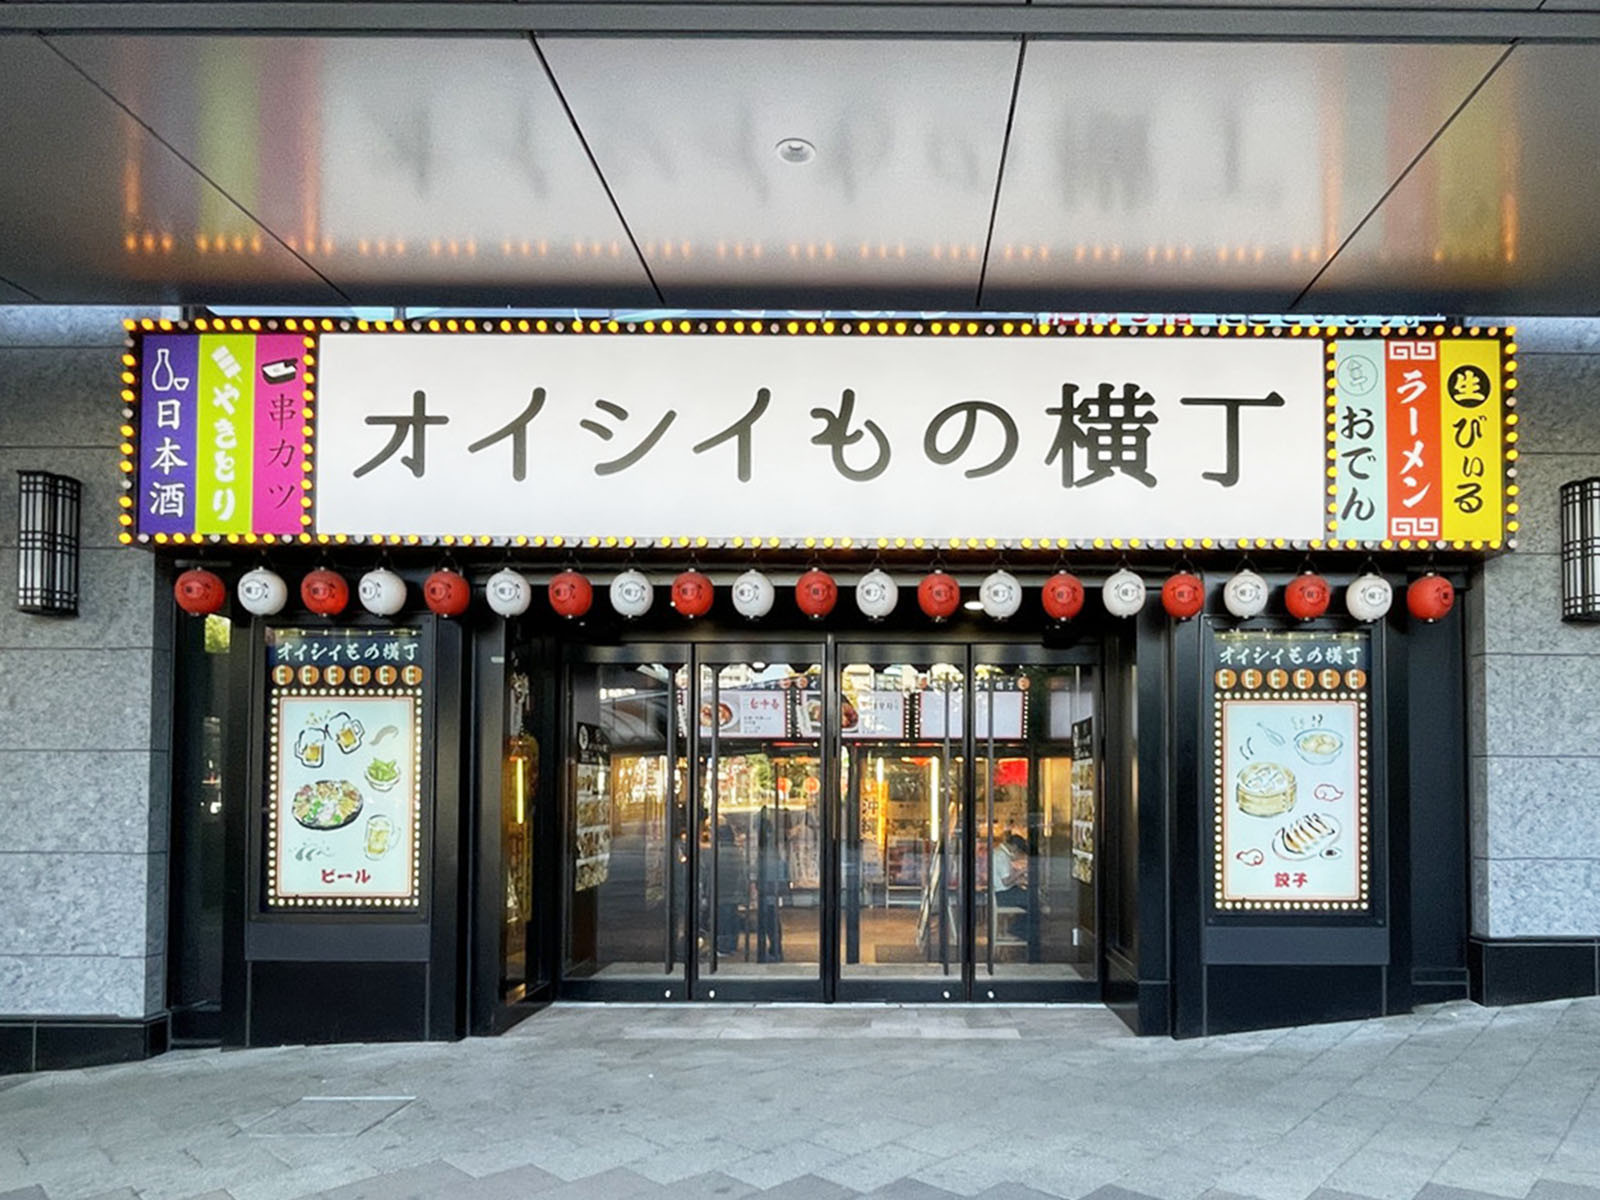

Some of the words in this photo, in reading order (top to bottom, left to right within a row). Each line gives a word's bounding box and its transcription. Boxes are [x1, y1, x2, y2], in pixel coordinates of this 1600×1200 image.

[150, 399, 188, 518] 日本酒
[212, 383, 240, 521] やきとり
[267, 393, 297, 510] 串カツ
[353, 382, 1286, 489] オイシイもの横丁
[1340, 406, 1377, 522] おでん
[1396, 369, 1432, 509] ラーメン
[321, 868, 371, 884] ビール
[1274, 872, 1309, 889] 餃子
